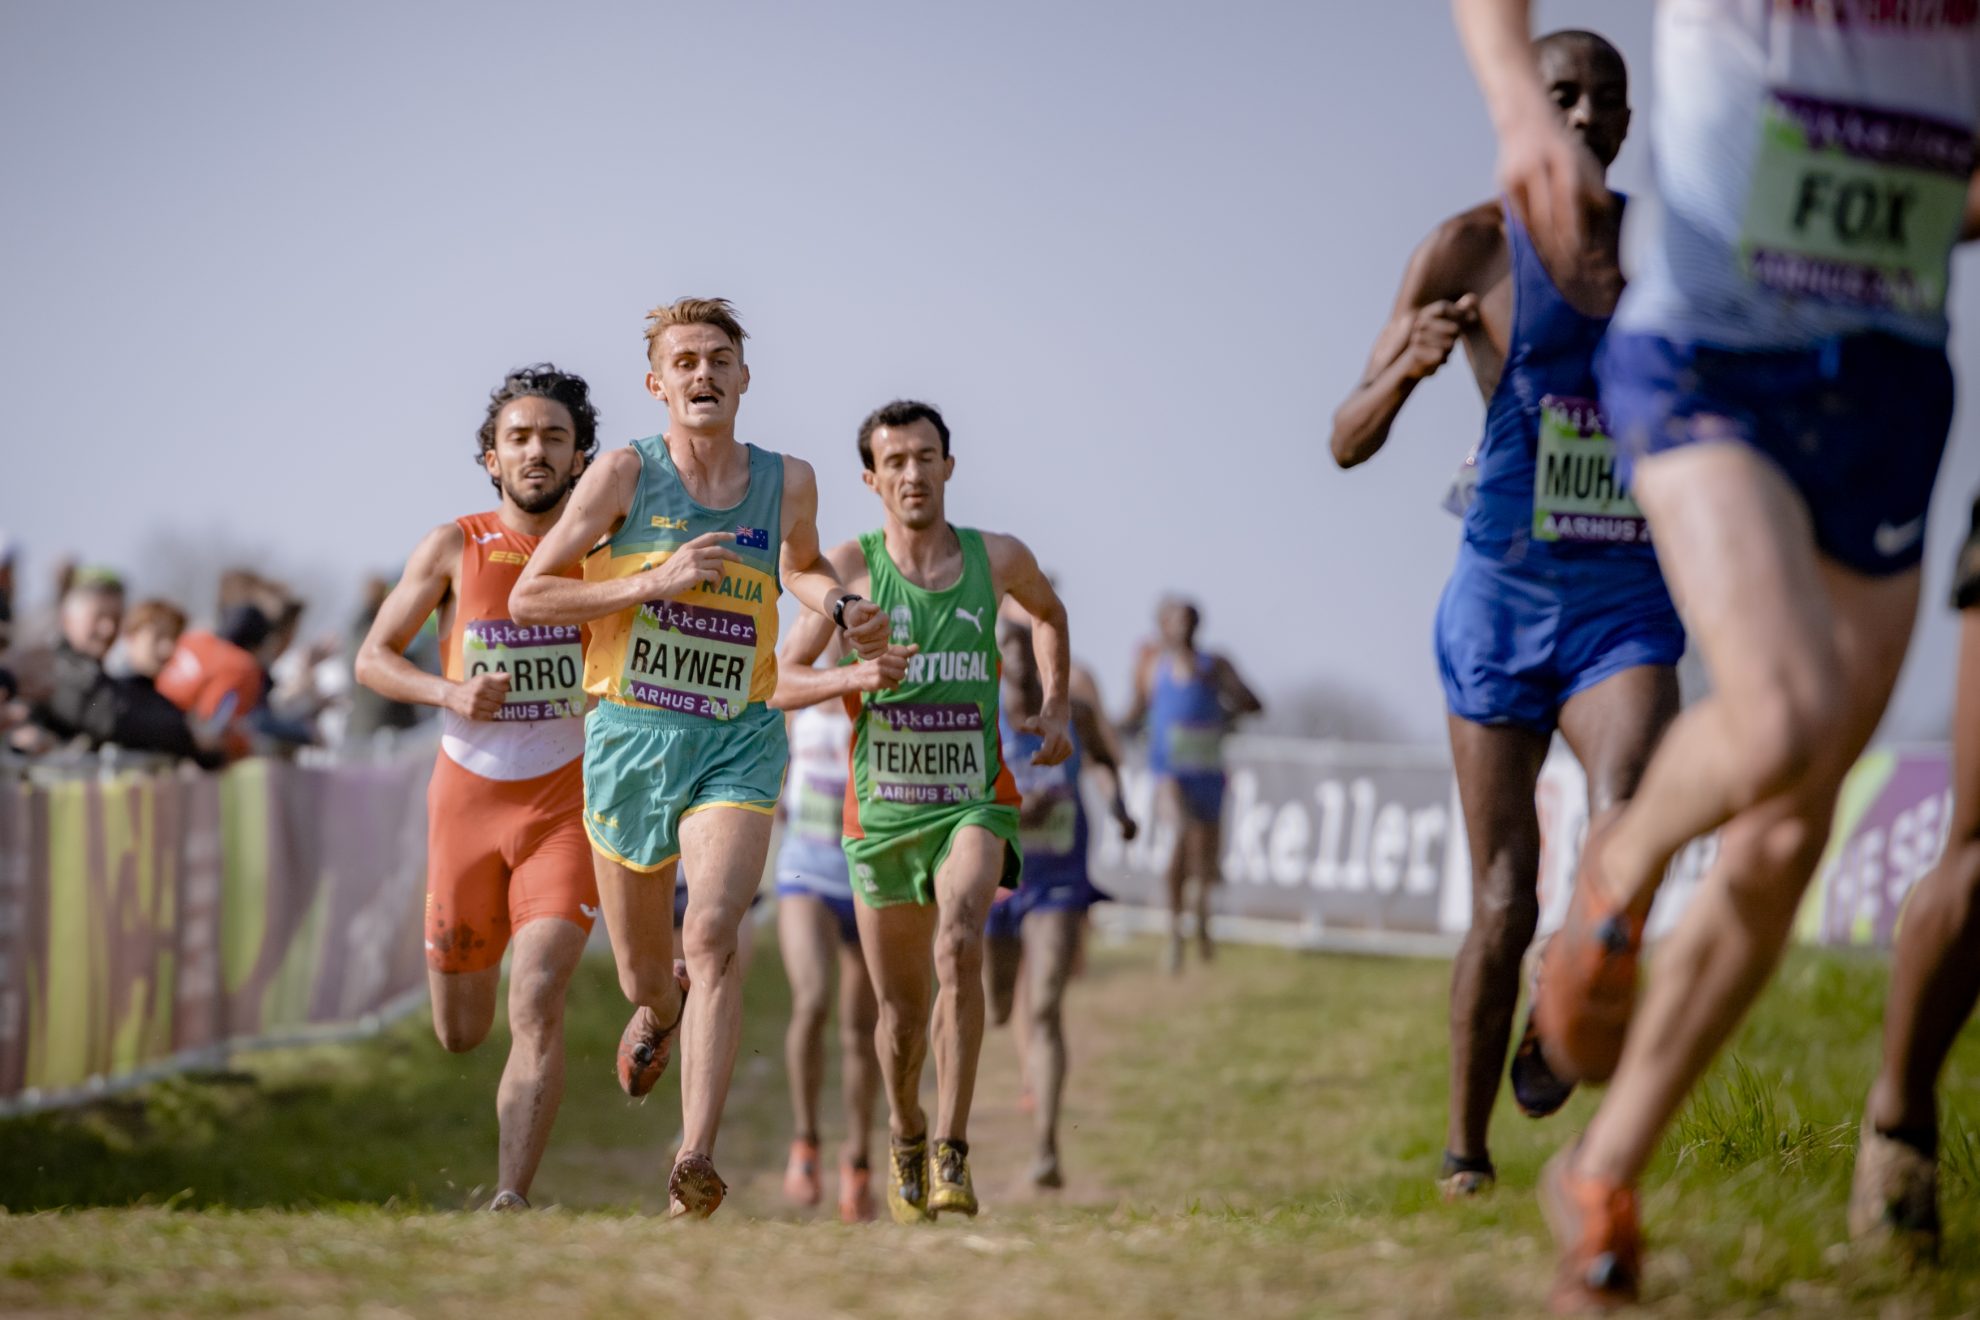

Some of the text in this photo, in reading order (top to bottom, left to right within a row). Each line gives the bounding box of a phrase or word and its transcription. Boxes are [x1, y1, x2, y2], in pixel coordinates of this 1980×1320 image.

[1790, 171, 1918, 248] FOX
[1545, 454, 1625, 501] MUH
[651, 515, 688, 531] BLK
[1543, 514, 1654, 541] AARHUS 2
[465, 625, 577, 643] Mikkeller
[640, 603, 754, 639] Mikkeller
[630, 638, 745, 691] RAYNER
[907, 651, 989, 684] RTUGAL
[494, 704, 539, 719] RHUS
[623, 684, 740, 716] AARHUS 2019
[872, 709, 979, 727] Mikkeller
[873, 741, 978, 775] TEIXEIRA
[874, 785, 938, 801] AARHUS
